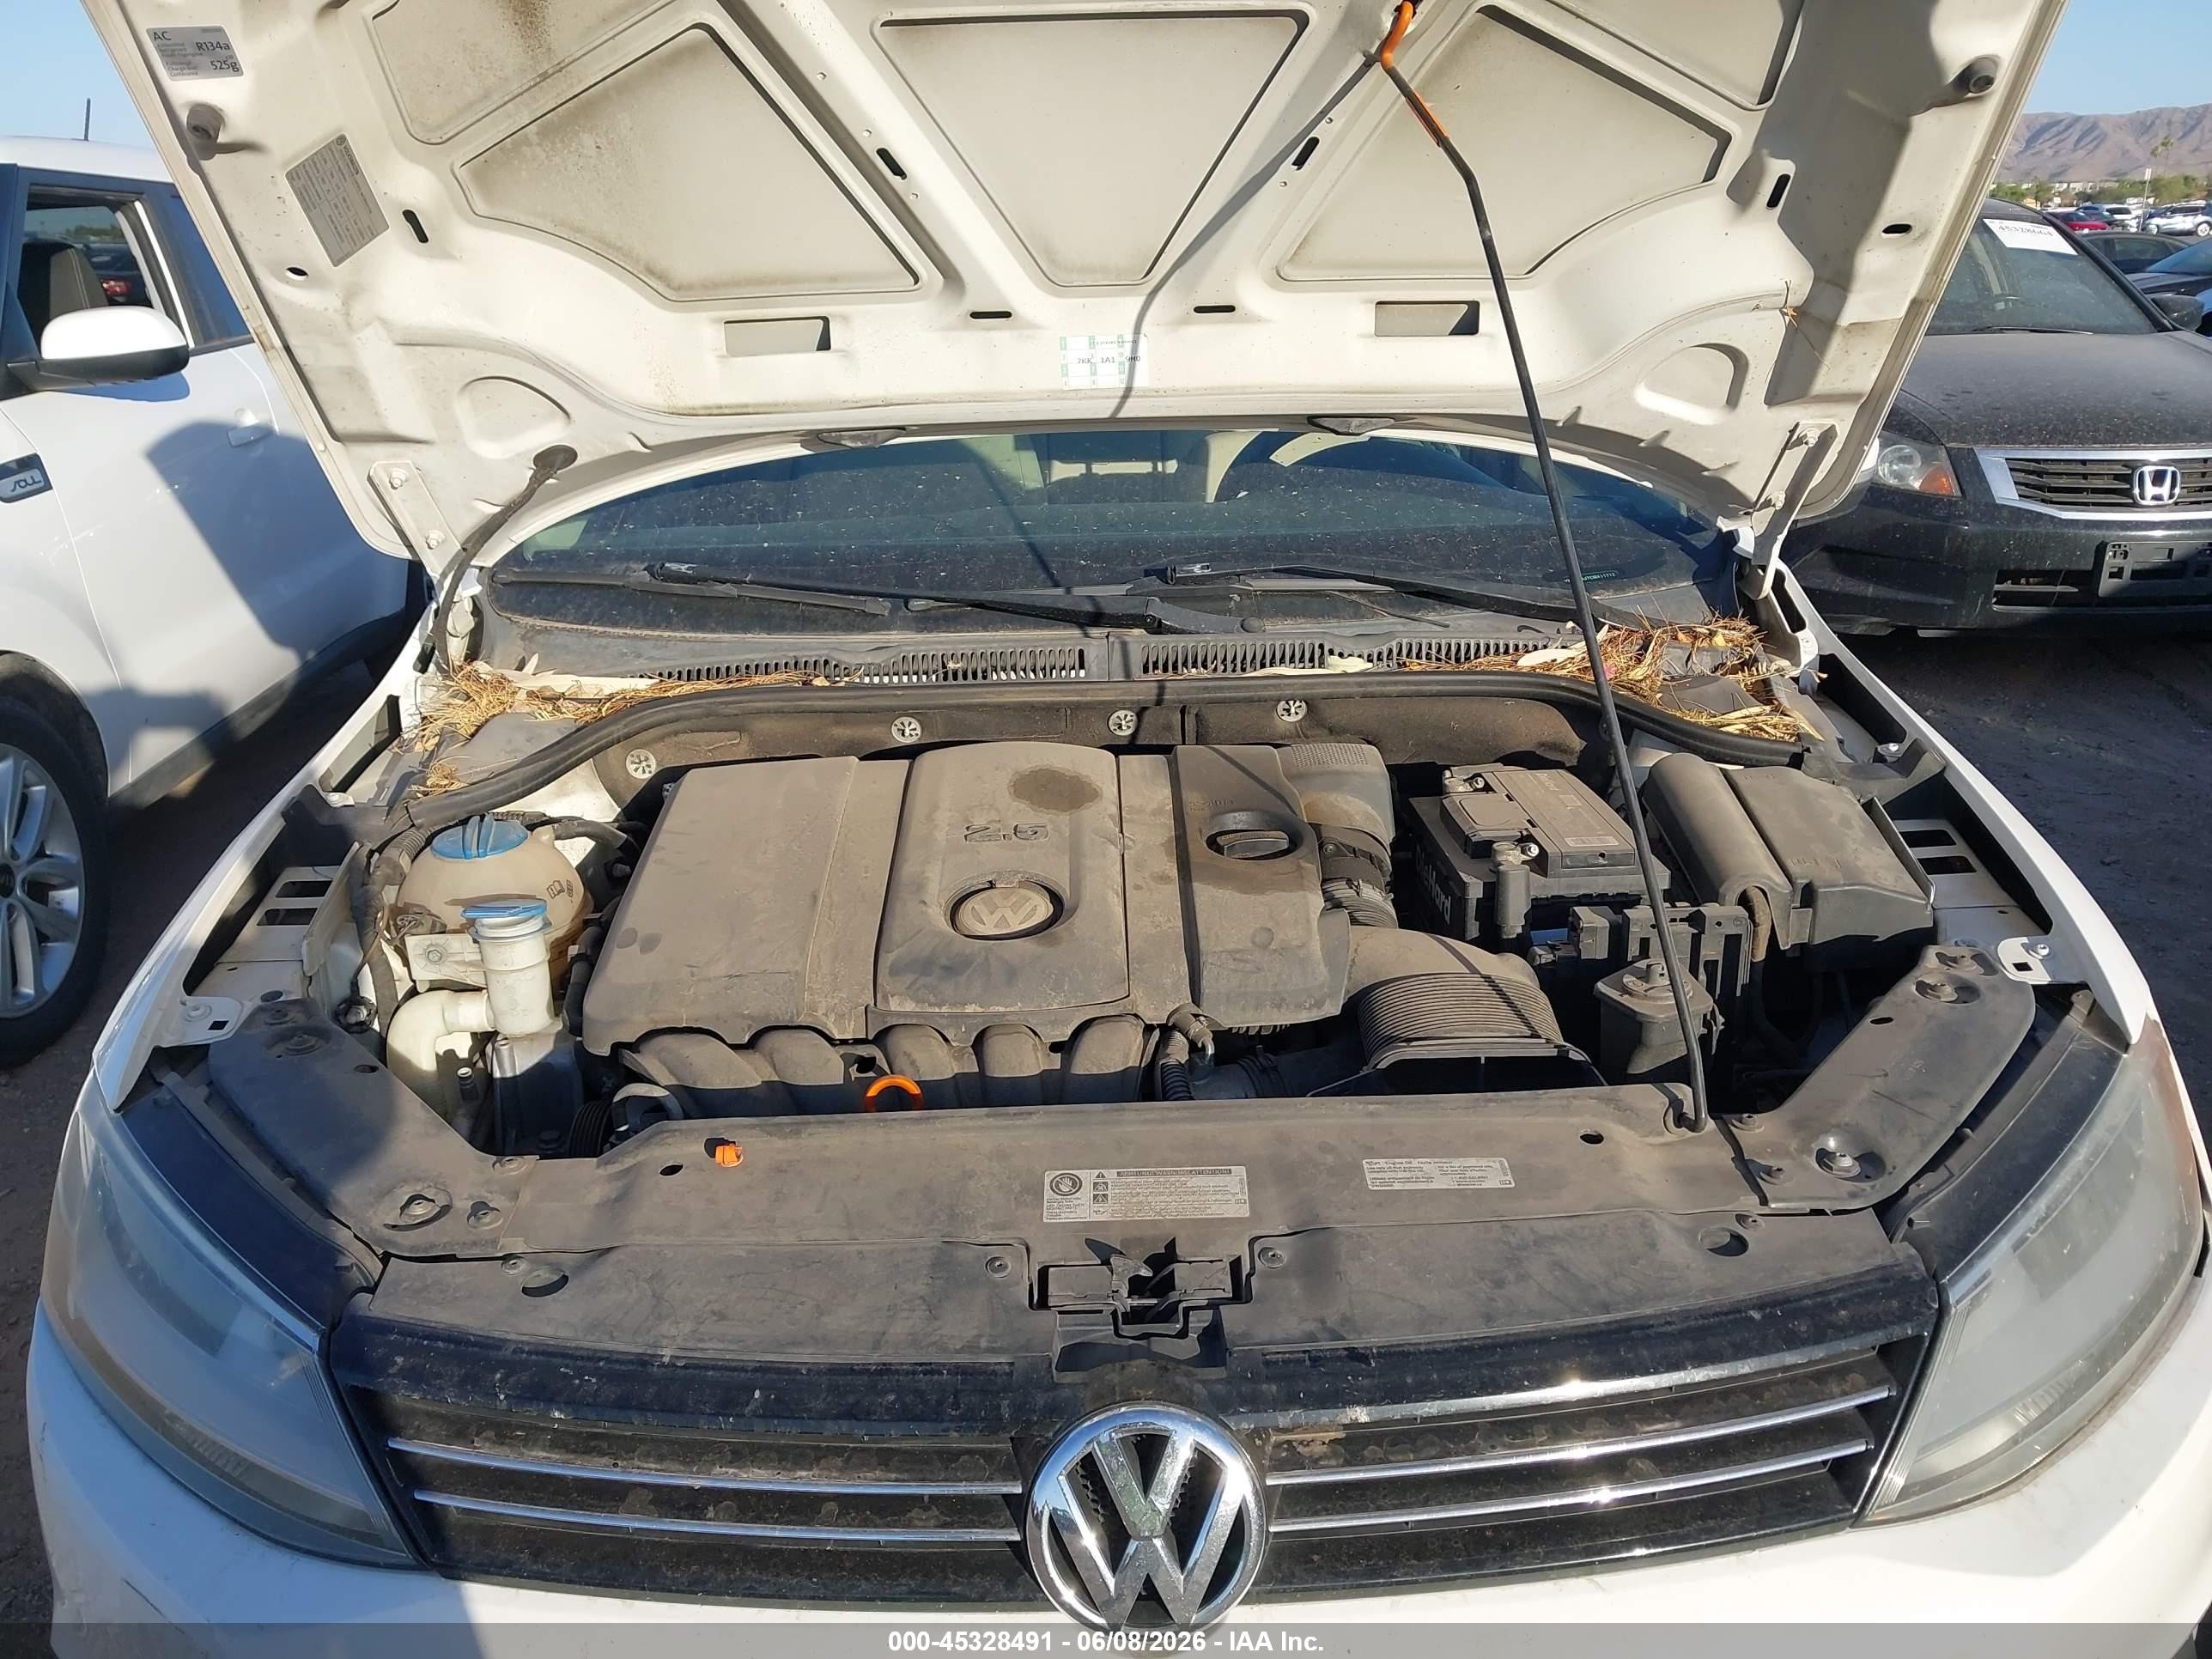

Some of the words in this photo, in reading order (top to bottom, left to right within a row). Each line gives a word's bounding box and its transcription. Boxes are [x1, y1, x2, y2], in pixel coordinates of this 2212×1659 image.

[153, 31, 171, 41] AC
[195, 41, 230, 52] R134a
[210, 60, 240, 72] 525g
